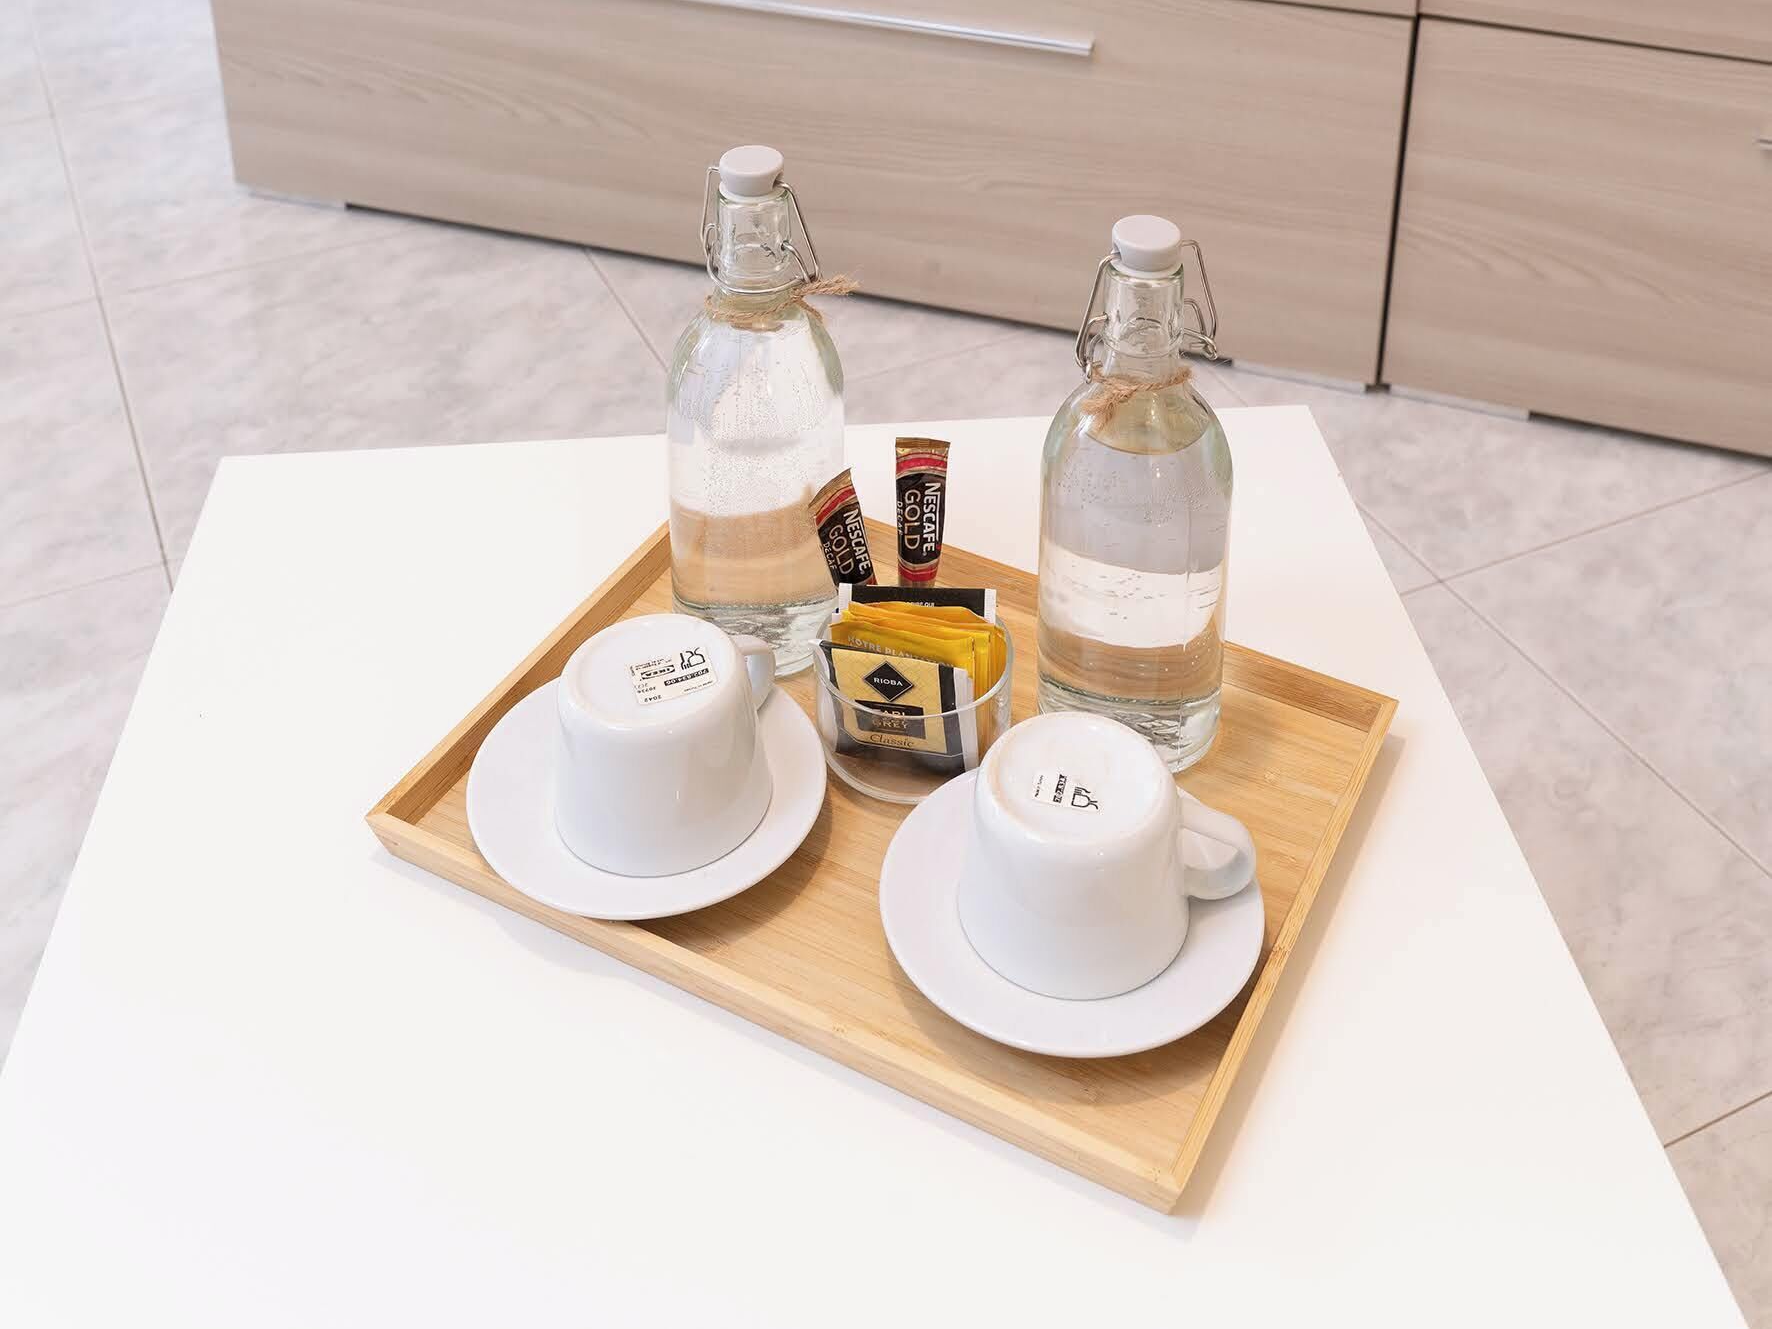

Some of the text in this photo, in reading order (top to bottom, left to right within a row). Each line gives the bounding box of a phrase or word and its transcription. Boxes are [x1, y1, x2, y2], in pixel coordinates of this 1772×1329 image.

[904, 489, 921, 550] GOLD
[822, 541, 838, 570] DECAF
[828, 524, 855, 575] GOLD
[847, 635, 882, 652] NOTRE
[873, 677, 904, 687] RIOBA
[870, 733, 914, 748] Classic
